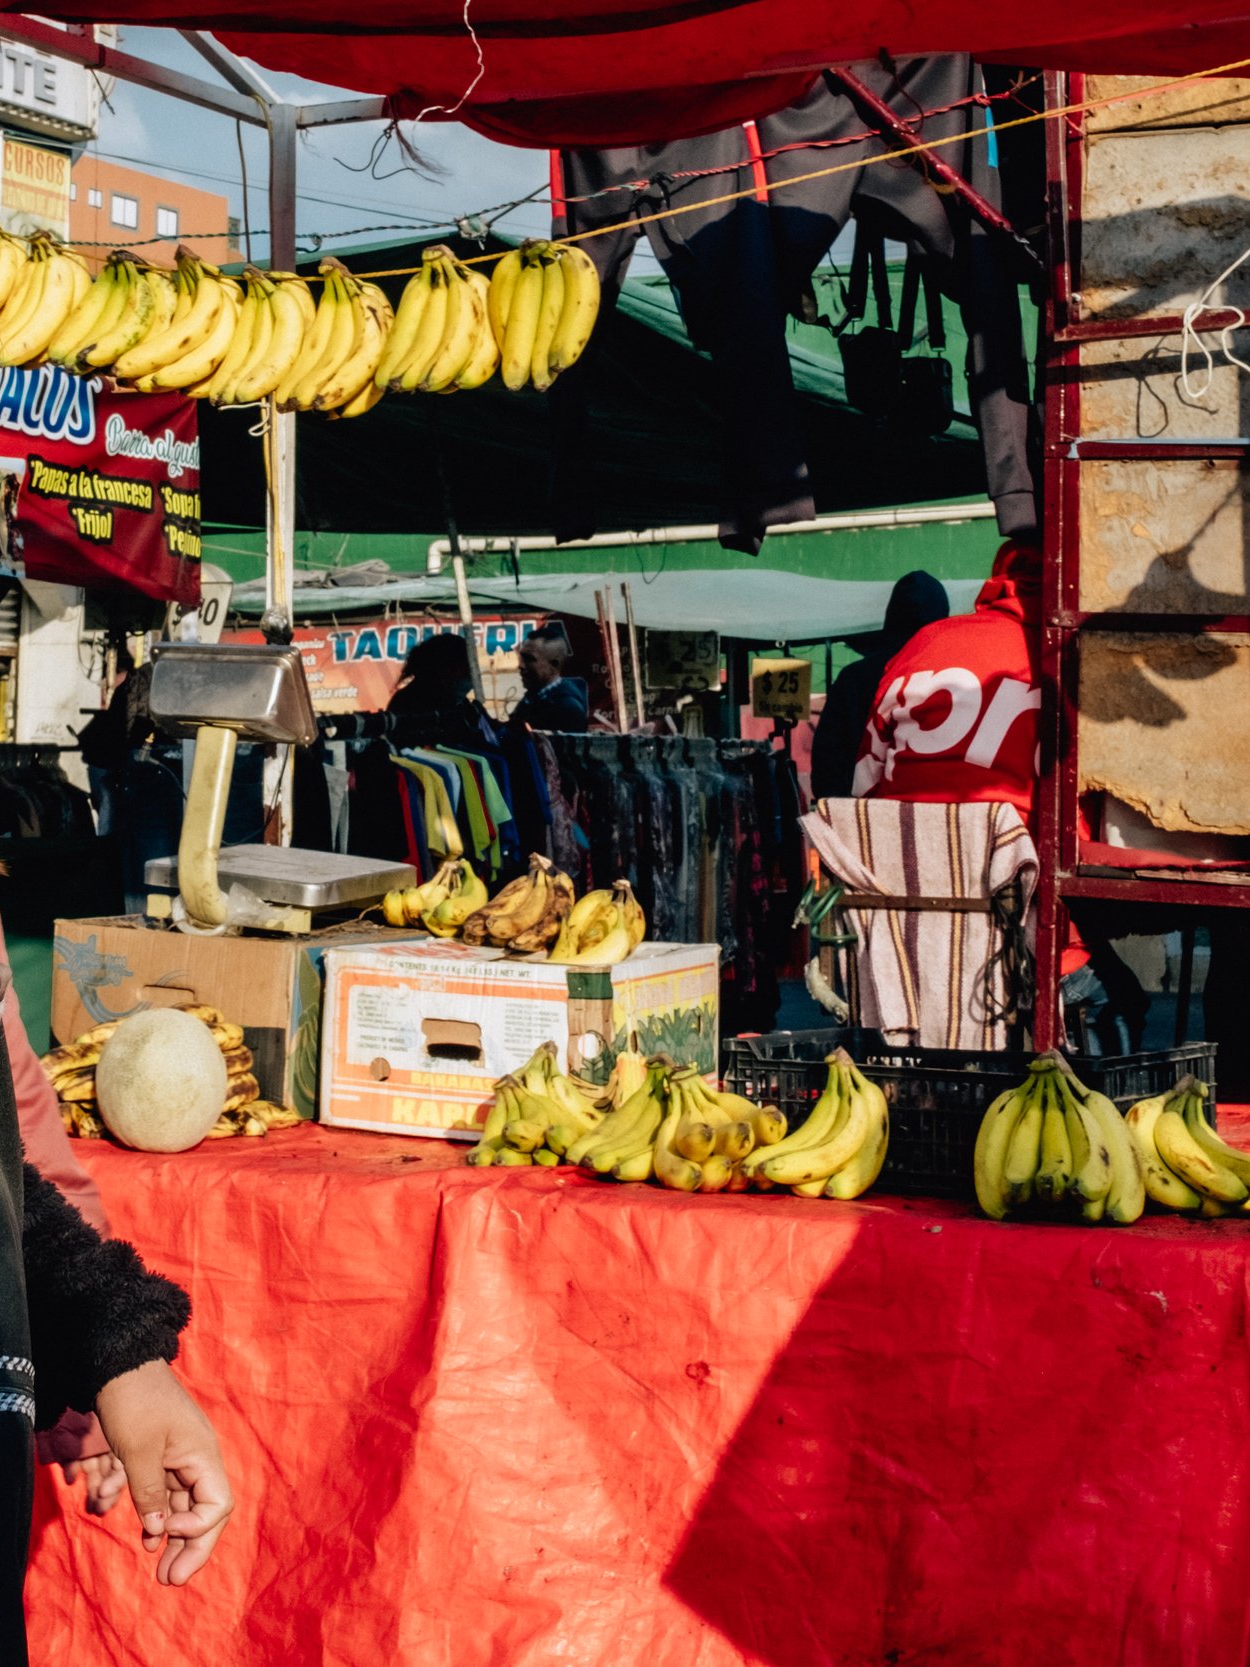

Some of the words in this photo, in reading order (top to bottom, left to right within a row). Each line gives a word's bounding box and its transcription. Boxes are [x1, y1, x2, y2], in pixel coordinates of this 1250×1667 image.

[4, 143, 65, 186] CURSOS
[69, 474, 78, 496] a
[79, 471, 93, 498] la
[93, 474, 152, 509] francesa
[327, 620, 573, 664] TAQRIA
[778, 672, 799, 693] 25
[411, 1071, 496, 1092] BANANAS
